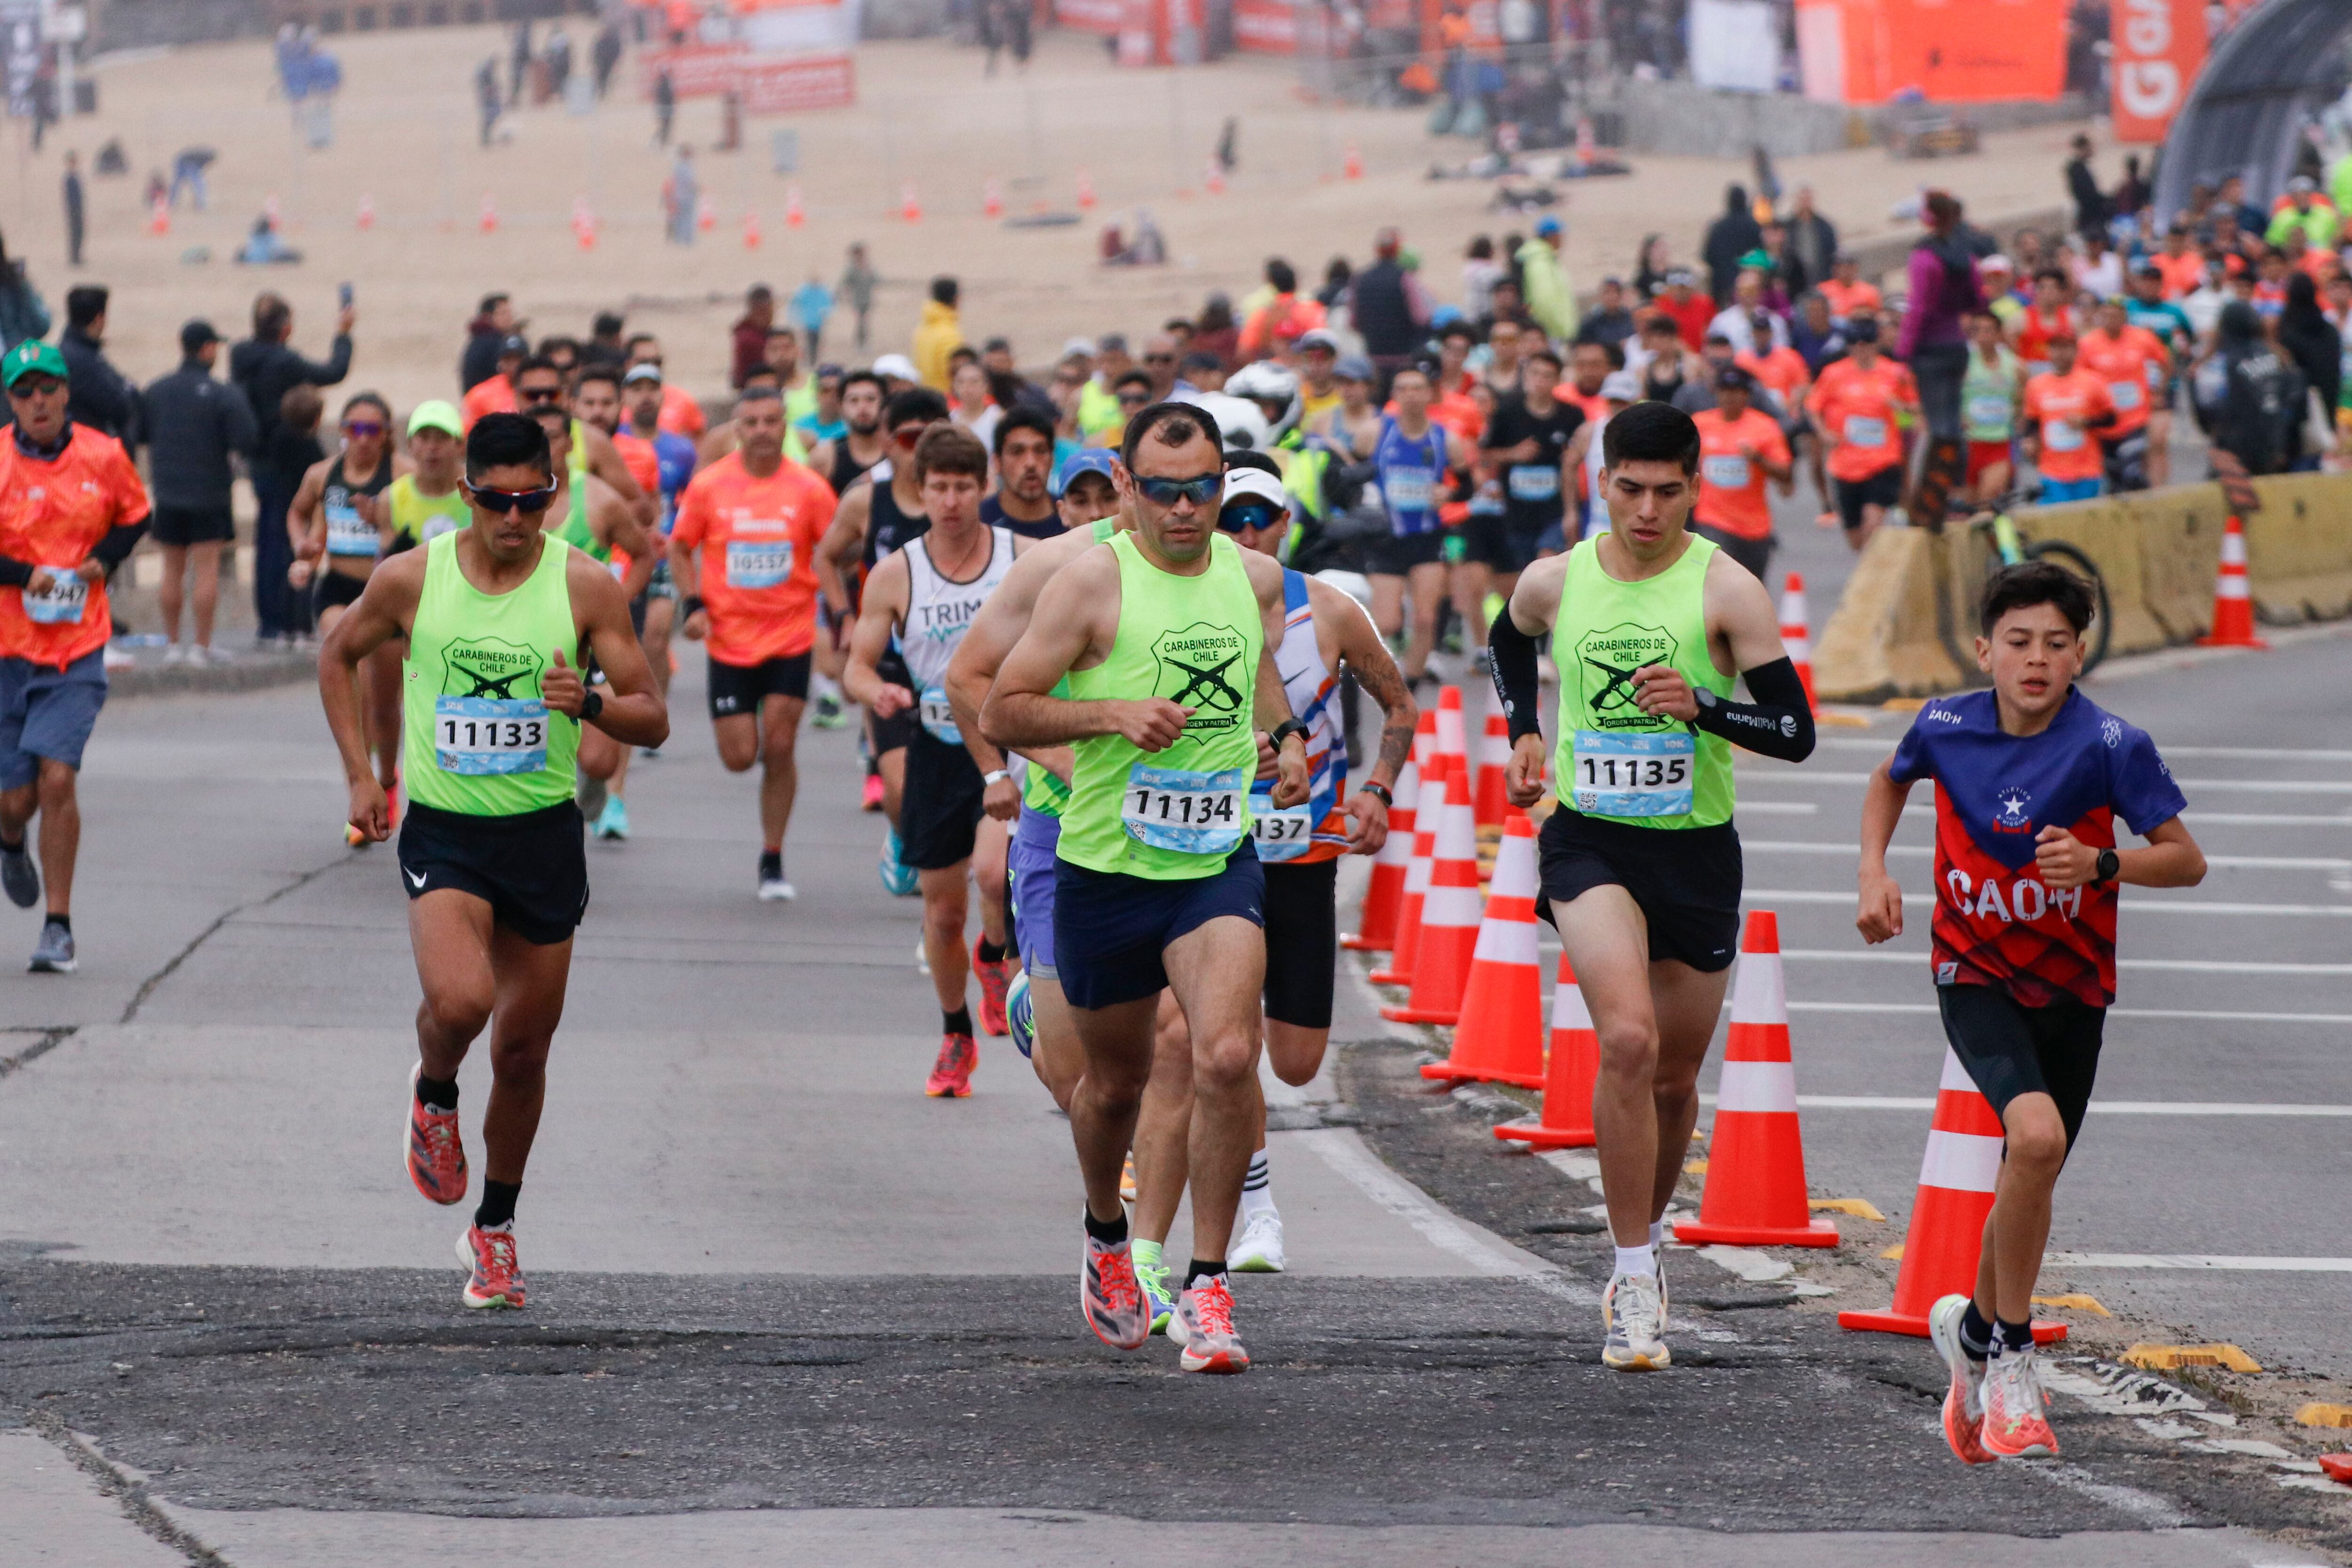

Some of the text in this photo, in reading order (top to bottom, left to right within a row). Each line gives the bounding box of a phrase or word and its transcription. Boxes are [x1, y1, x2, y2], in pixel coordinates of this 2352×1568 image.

[1164, 637, 1239, 653] CARABINEROS DE
[1585, 638, 1666, 653] CARABINEROS DE
[453, 648, 532, 665] CARABINEROS DE
[1193, 651, 1219, 662] CHILE
[1613, 651, 1640, 662] CHILE
[479, 662, 505, 673] CHILE
[1606, 718, 1629, 727] ORDEN
[1726, 712, 1776, 730] MallMarina
[445, 720, 541, 747] 11133
[1583, 737, 1685, 748] 10K 10K
[1583, 758, 1685, 787] 11135
[1136, 790, 1233, 823] 11134
